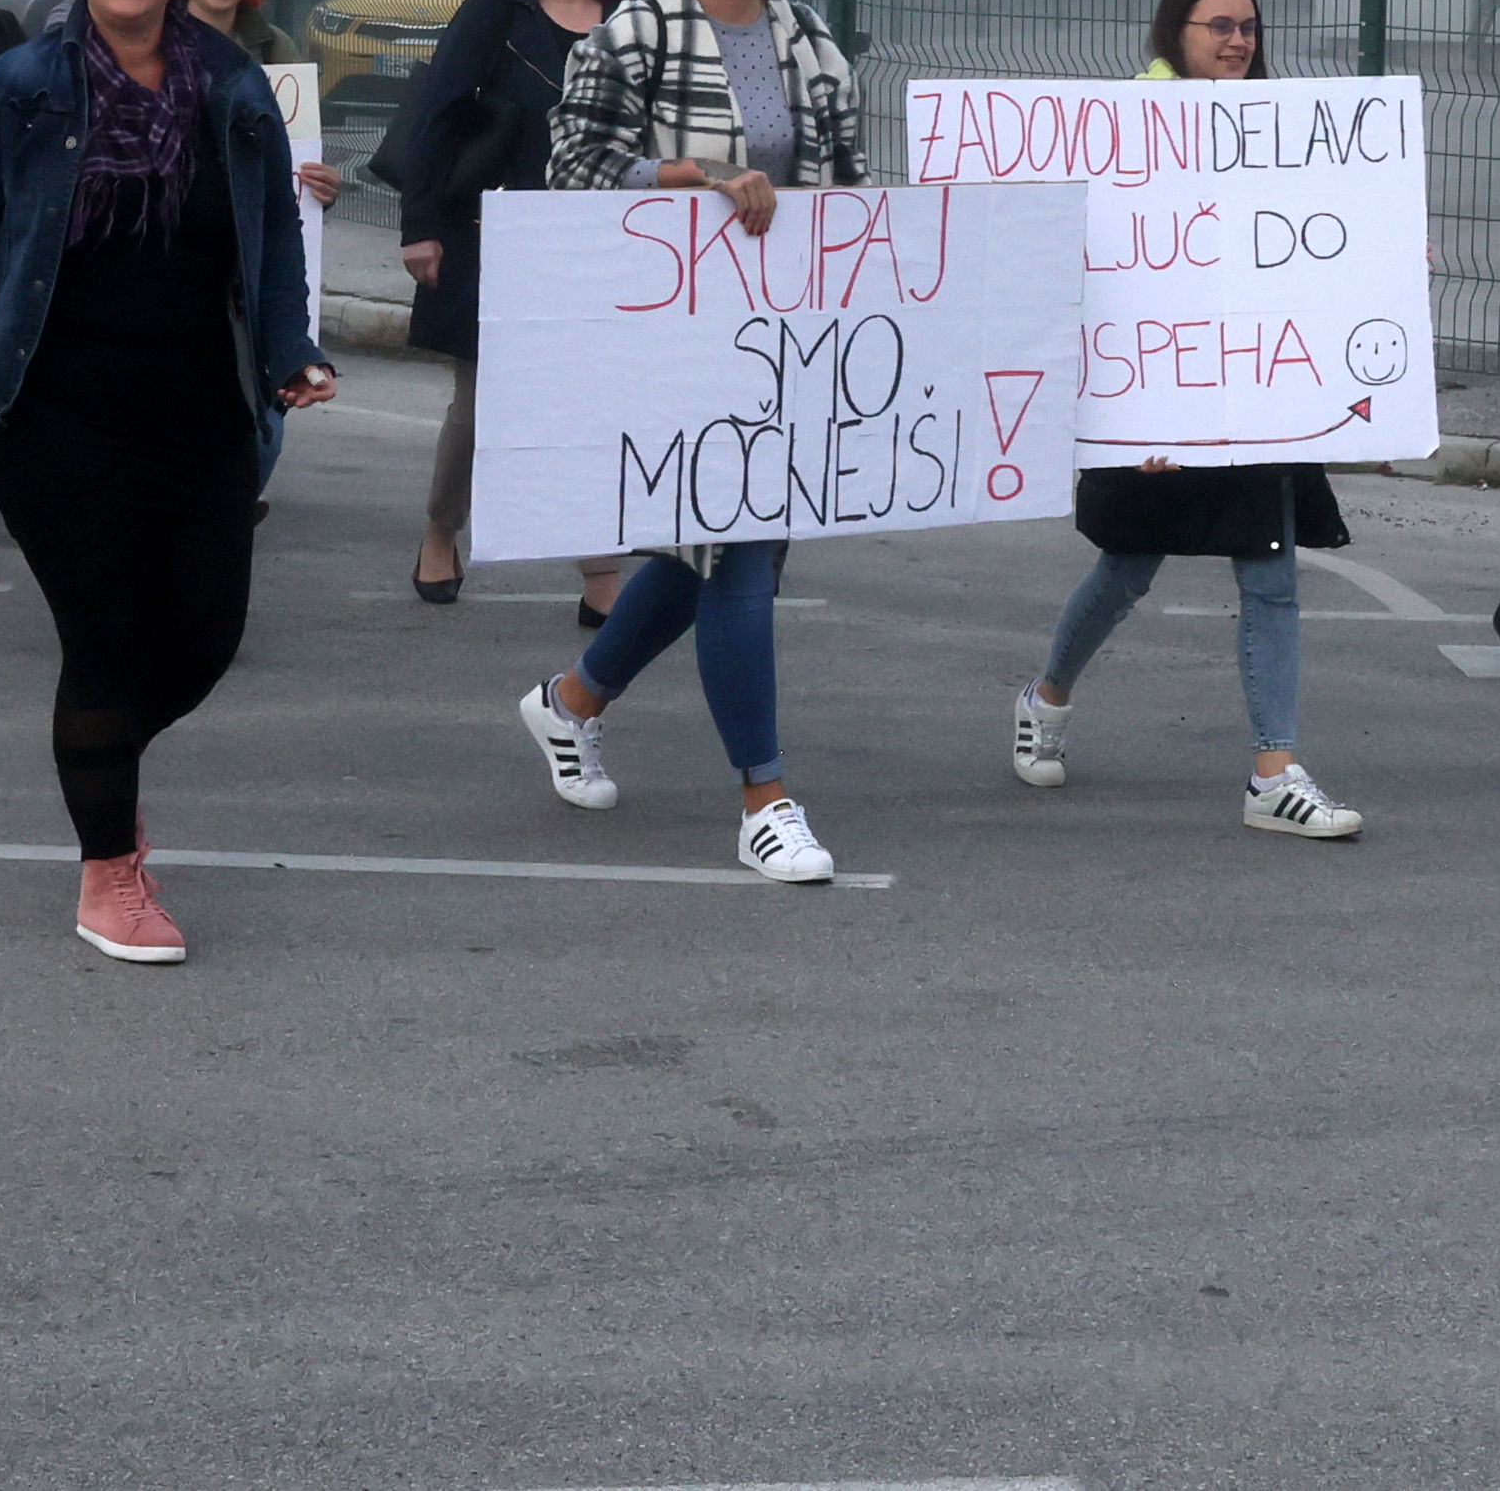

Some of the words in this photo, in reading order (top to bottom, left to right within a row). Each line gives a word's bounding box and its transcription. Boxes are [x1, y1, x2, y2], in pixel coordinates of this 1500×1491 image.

[913, 90, 1200, 187] ZADOVOLJNI
[1212, 97, 1406, 172] DELAVCI
[614, 186, 950, 315] SKUPAJ
[1254, 211, 1347, 269] DO
[729, 314, 903, 427] SMO
